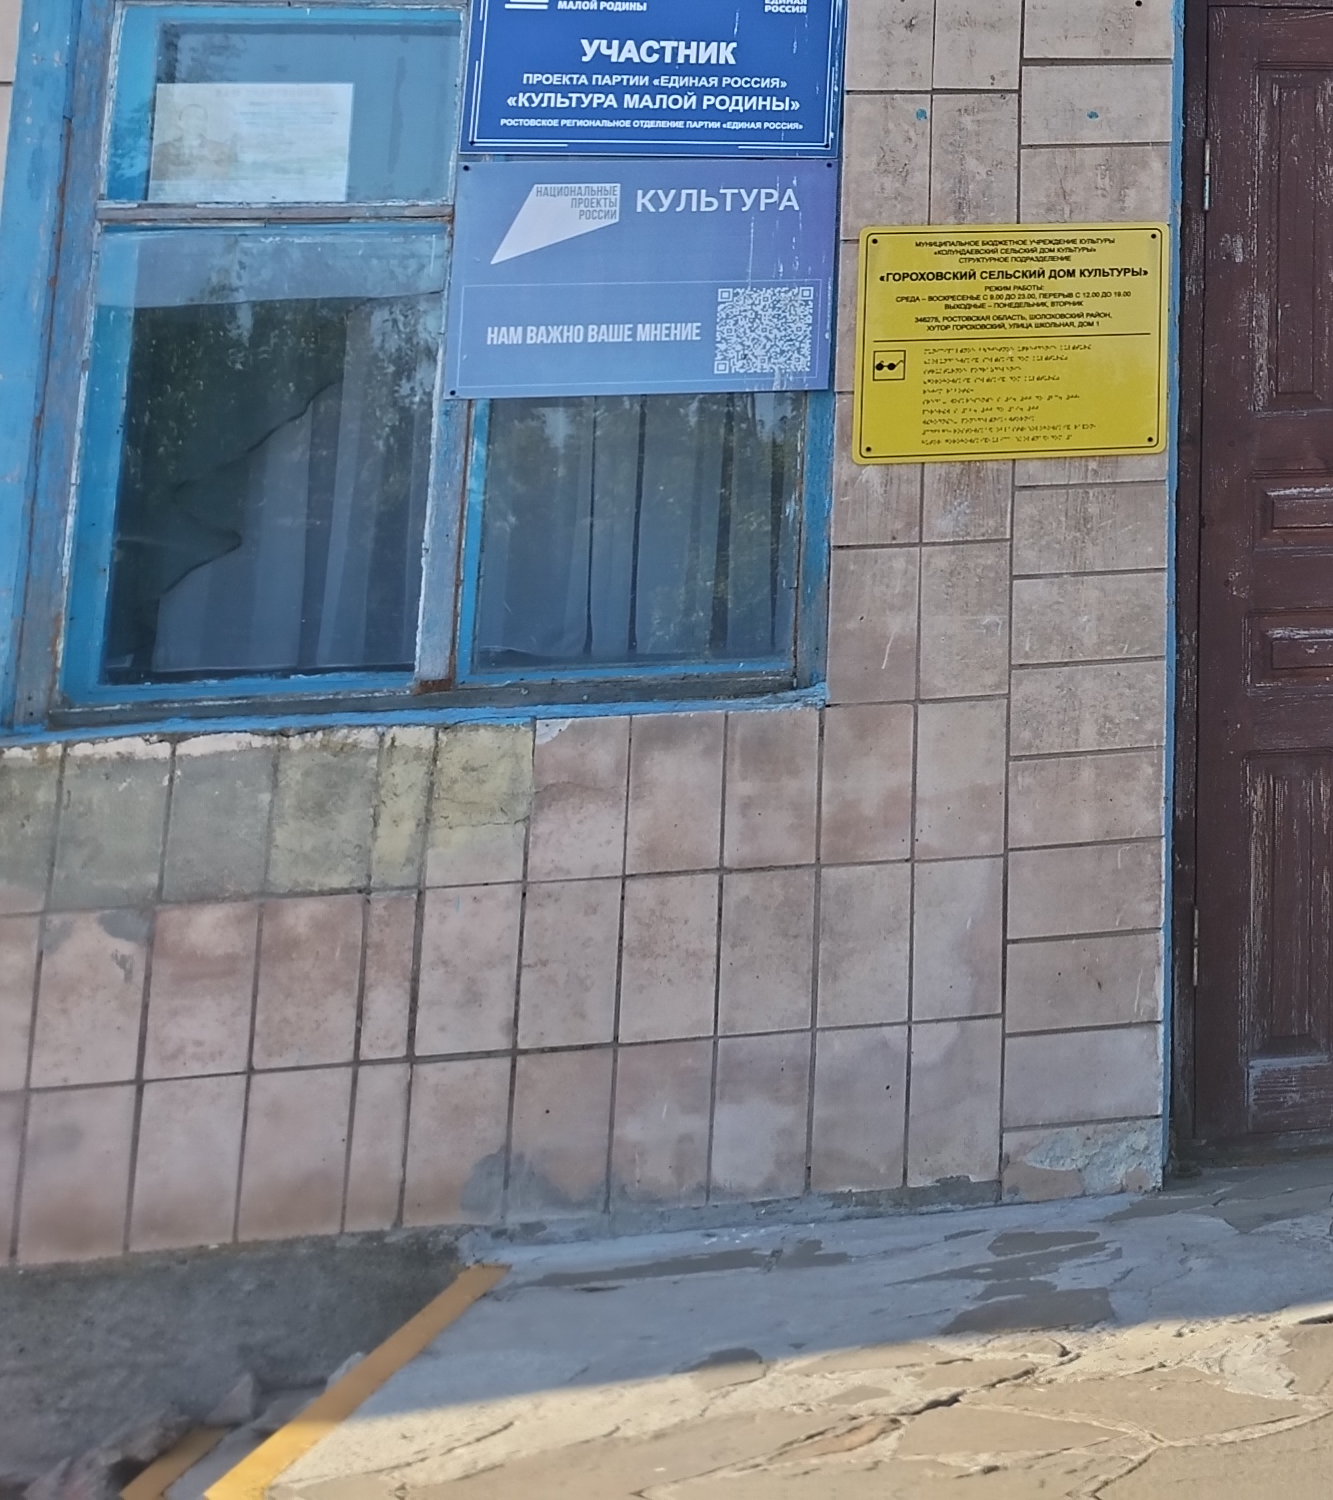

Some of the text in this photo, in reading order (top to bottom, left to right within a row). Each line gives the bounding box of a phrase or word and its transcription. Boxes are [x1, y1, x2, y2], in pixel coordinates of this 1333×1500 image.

[557, 0, 648, 12] МАЛОЙ РОДИНЫ
[764, 4, 807, 14] РОССИЯ
[580, 38, 738, 65] УЧАСТНИК
[522, 72, 788, 89] ПРОЕКТА ПАРТИИ «ЕДИНАЯ РОССИЯ»
[506, 91, 801, 112] «КУЛЬТУРА МАЛОЙ РОДИНЫ»
[500, 118, 804, 130] РОСТОВСКОЕ РЕГИОНАЛЬНОЕ ОТДЕЛЕНИЕ ПАРТИИ «ЕДИНАЯ РОССИЯ»
[536, 185, 618, 197] НАЦИОНАЛЬНЫЕ
[570, 197, 618, 208] ПРОЕКТЫ
[635, 187, 800, 213] КУЛЬТУРА
[578, 209, 617, 220] РОССИИ
[915, 240, 979, 248] МУНИЦИПАЛЬНОЕ
[981, 239, 1028, 247] БЮДЖЕТНОЕ
[1011, 255, 1071, 263] ПОДРАЗДЕЛЕНИЕ
[879, 267, 1149, 282] «ГОРОХОВСКИЙ СЕЛЬСКИЙ ДОМ КУЛЬТУРЫ»
[928, 294, 981, 302] ВОСКРЕСЕНЬЕ
[486, 322, 702, 345] НАМ ВАЖНО ВАШЕ МНЕНИЕ
